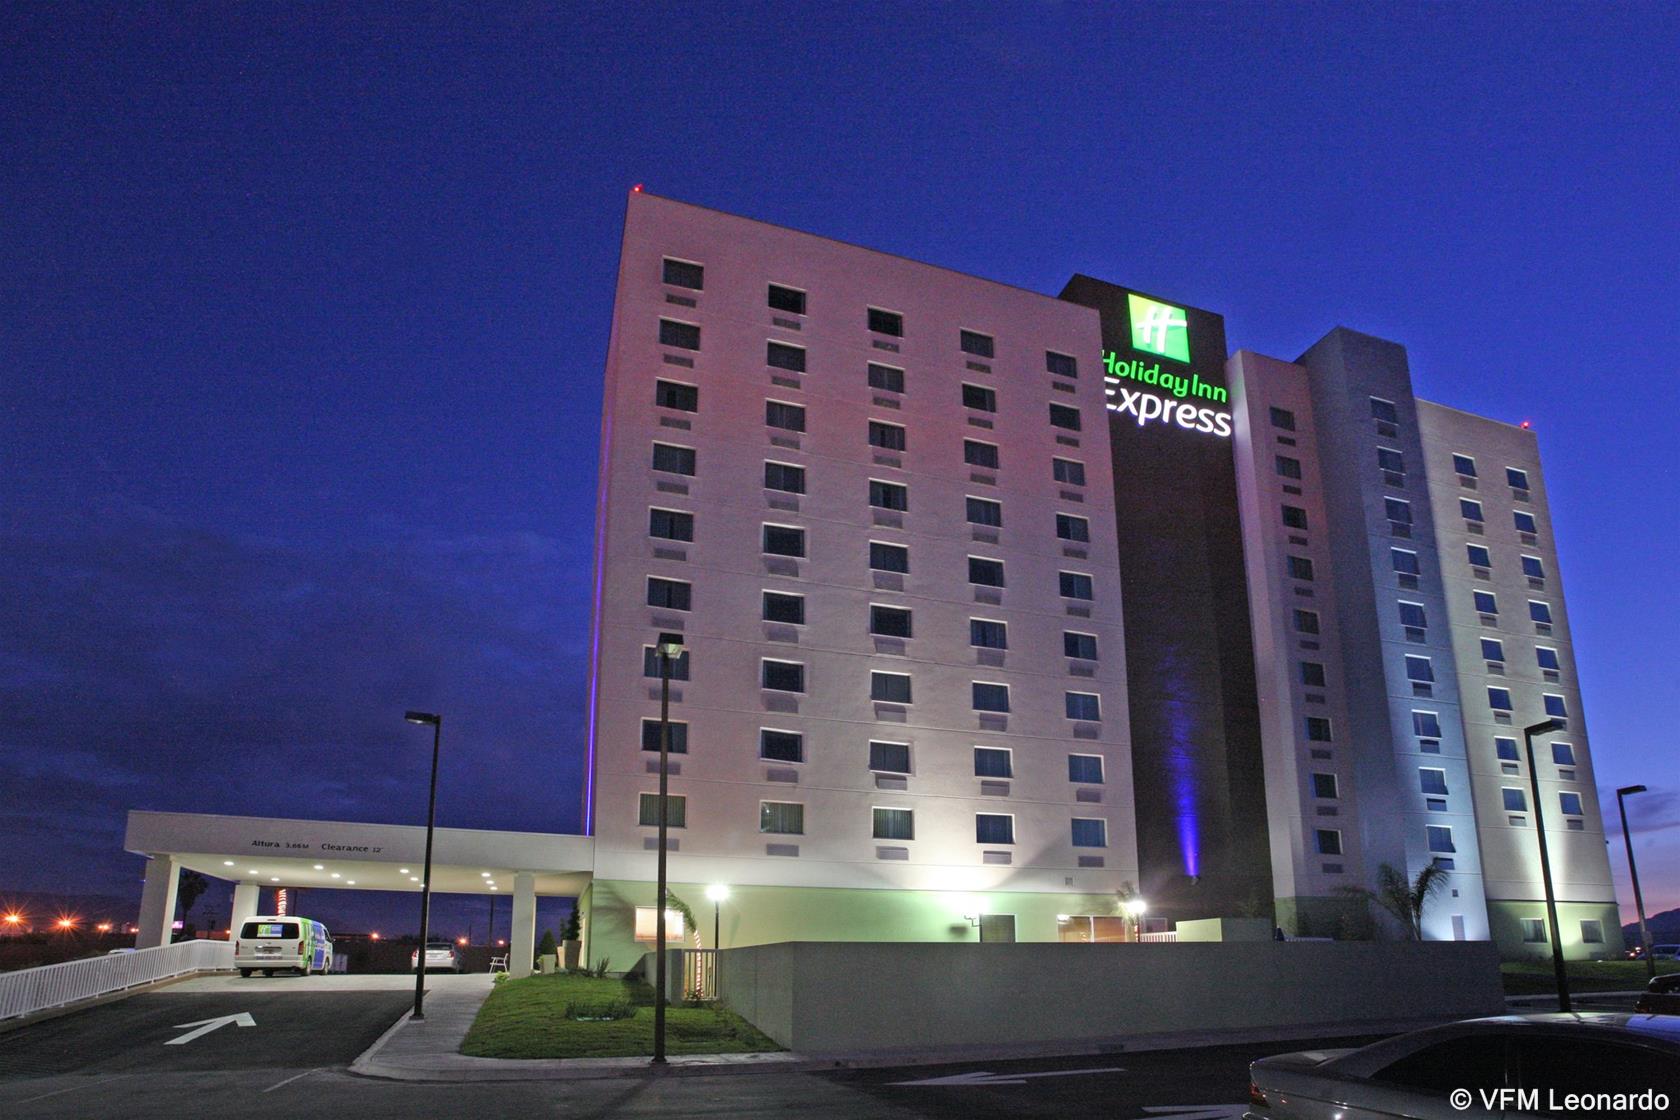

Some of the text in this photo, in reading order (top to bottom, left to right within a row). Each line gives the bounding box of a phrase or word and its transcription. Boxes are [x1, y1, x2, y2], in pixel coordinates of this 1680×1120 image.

[1102, 349, 1228, 404] Holiday Inn
[1103, 375, 1233, 438] Express
[251, 839, 280, 849] Altura
[321, 842, 369, 853] Clearance
